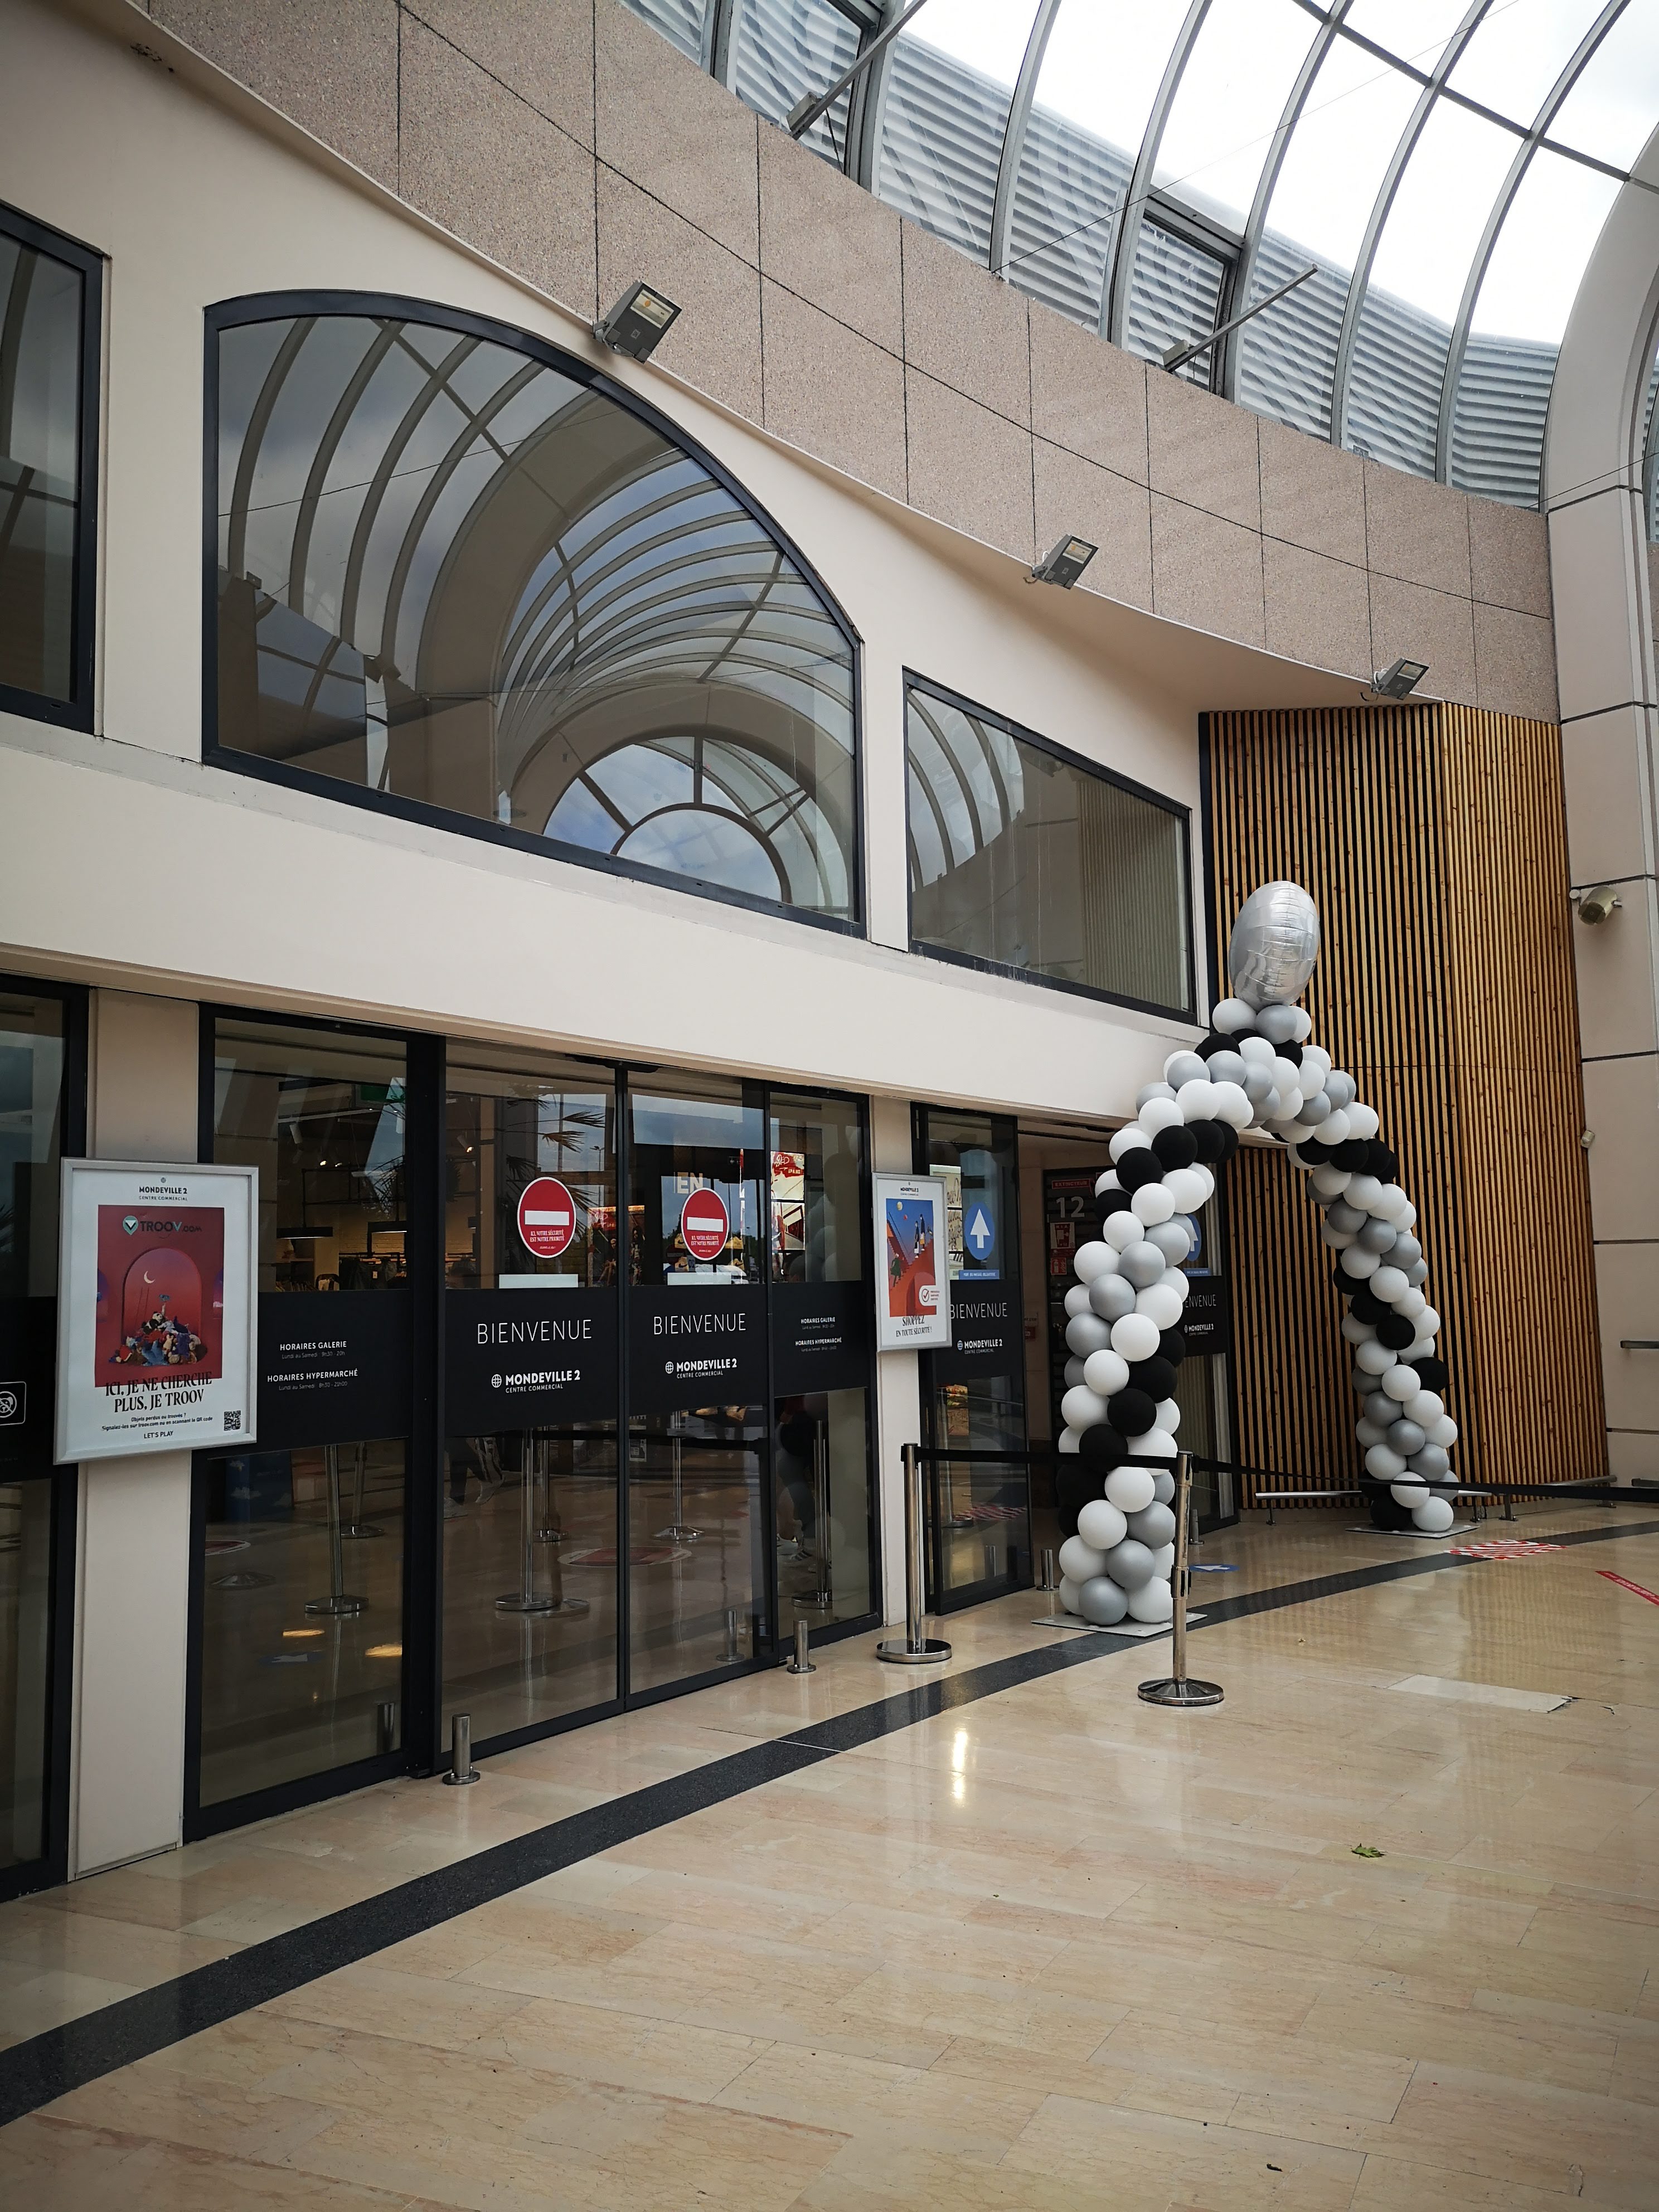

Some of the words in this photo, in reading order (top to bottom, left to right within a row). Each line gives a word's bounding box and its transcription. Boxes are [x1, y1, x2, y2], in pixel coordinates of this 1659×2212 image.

[1056, 1196, 1085, 1218] 12
[1183, 1294, 1216, 1308] ENVENUE
[950, 1303, 1007, 1319] BIENVENUE
[654, 1313, 746, 1335] BIENVENUE
[903, 1316, 925, 1326] SHOPPEZ
[1189, 1323, 1211, 1332] MONDEVILLE
[478, 1320, 592, 1344] BIENVENUE
[280, 1342, 316, 1351] HORAIRES
[964, 1339, 998, 1349] MONDEVILLE
[676, 1359, 730, 1372] MONDEVILLE
[732, 1358, 737, 1368] 2
[267, 1373, 304, 1382] HORAIRES
[306, 1368, 358, 1380] HYPERMARCHÉ
[506, 1370, 572, 1385] MONDEVILLE
[574, 1370, 580, 1380] 2
[105, 1381, 124, 1396] ICI,
[127, 1379, 139, 1396] JE
[142, 1377, 158, 1393] NE
[161, 1371, 212, 1390] CHERCHE
[114, 1396, 147, 1413] PLUS,
[150, 1394, 162, 1410] JE
[165, 1389, 204, 1406] TROOV
